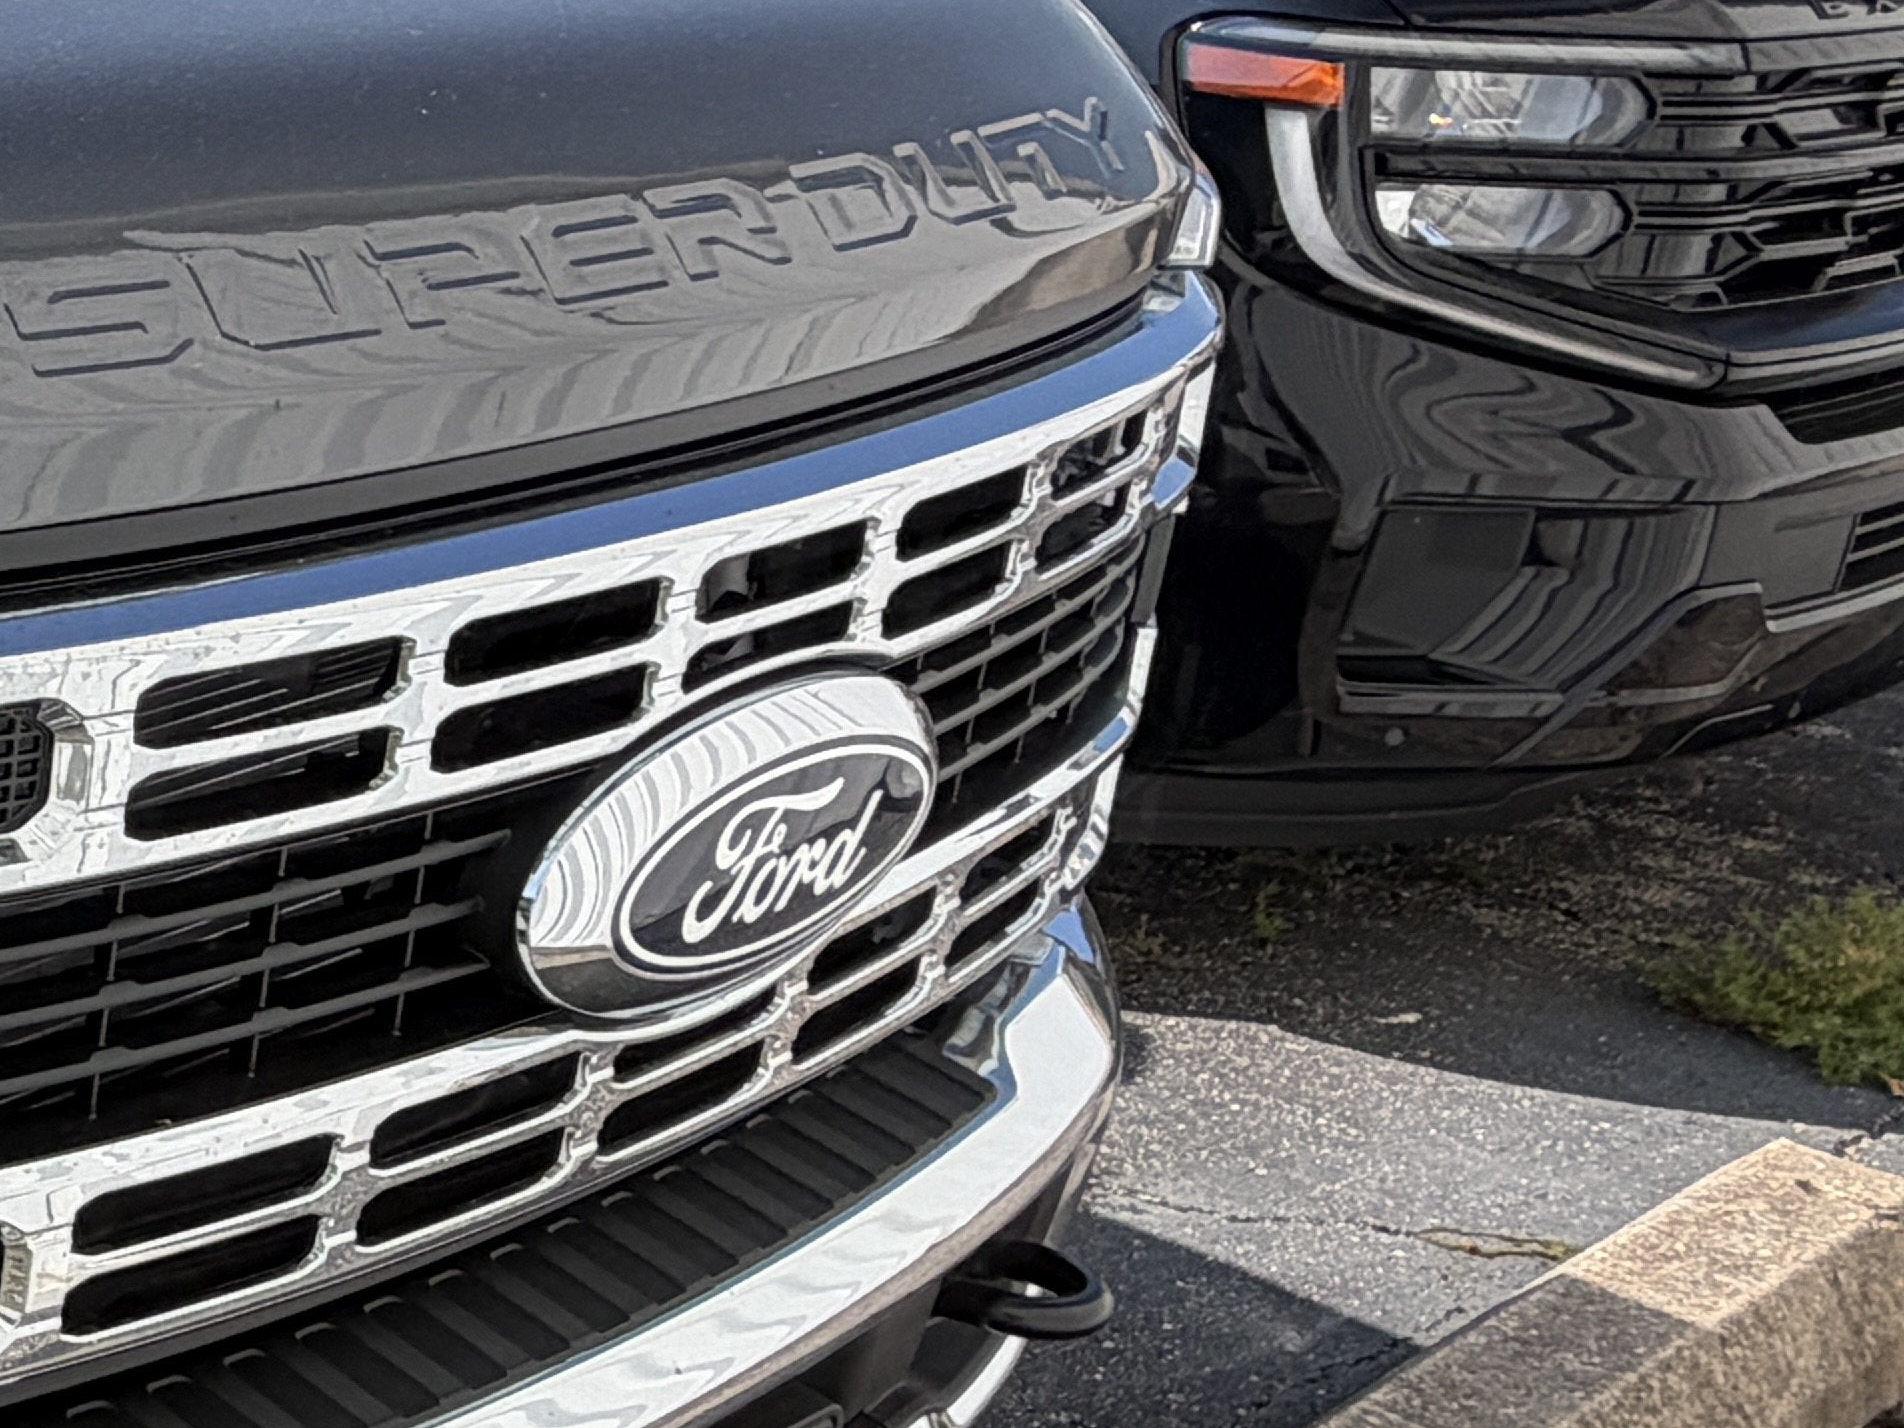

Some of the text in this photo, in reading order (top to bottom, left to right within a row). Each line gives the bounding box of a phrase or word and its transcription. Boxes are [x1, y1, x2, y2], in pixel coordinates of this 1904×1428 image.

[3, 95, 1127, 378] SUPER DUTY
[681, 776, 883, 944] Ford
